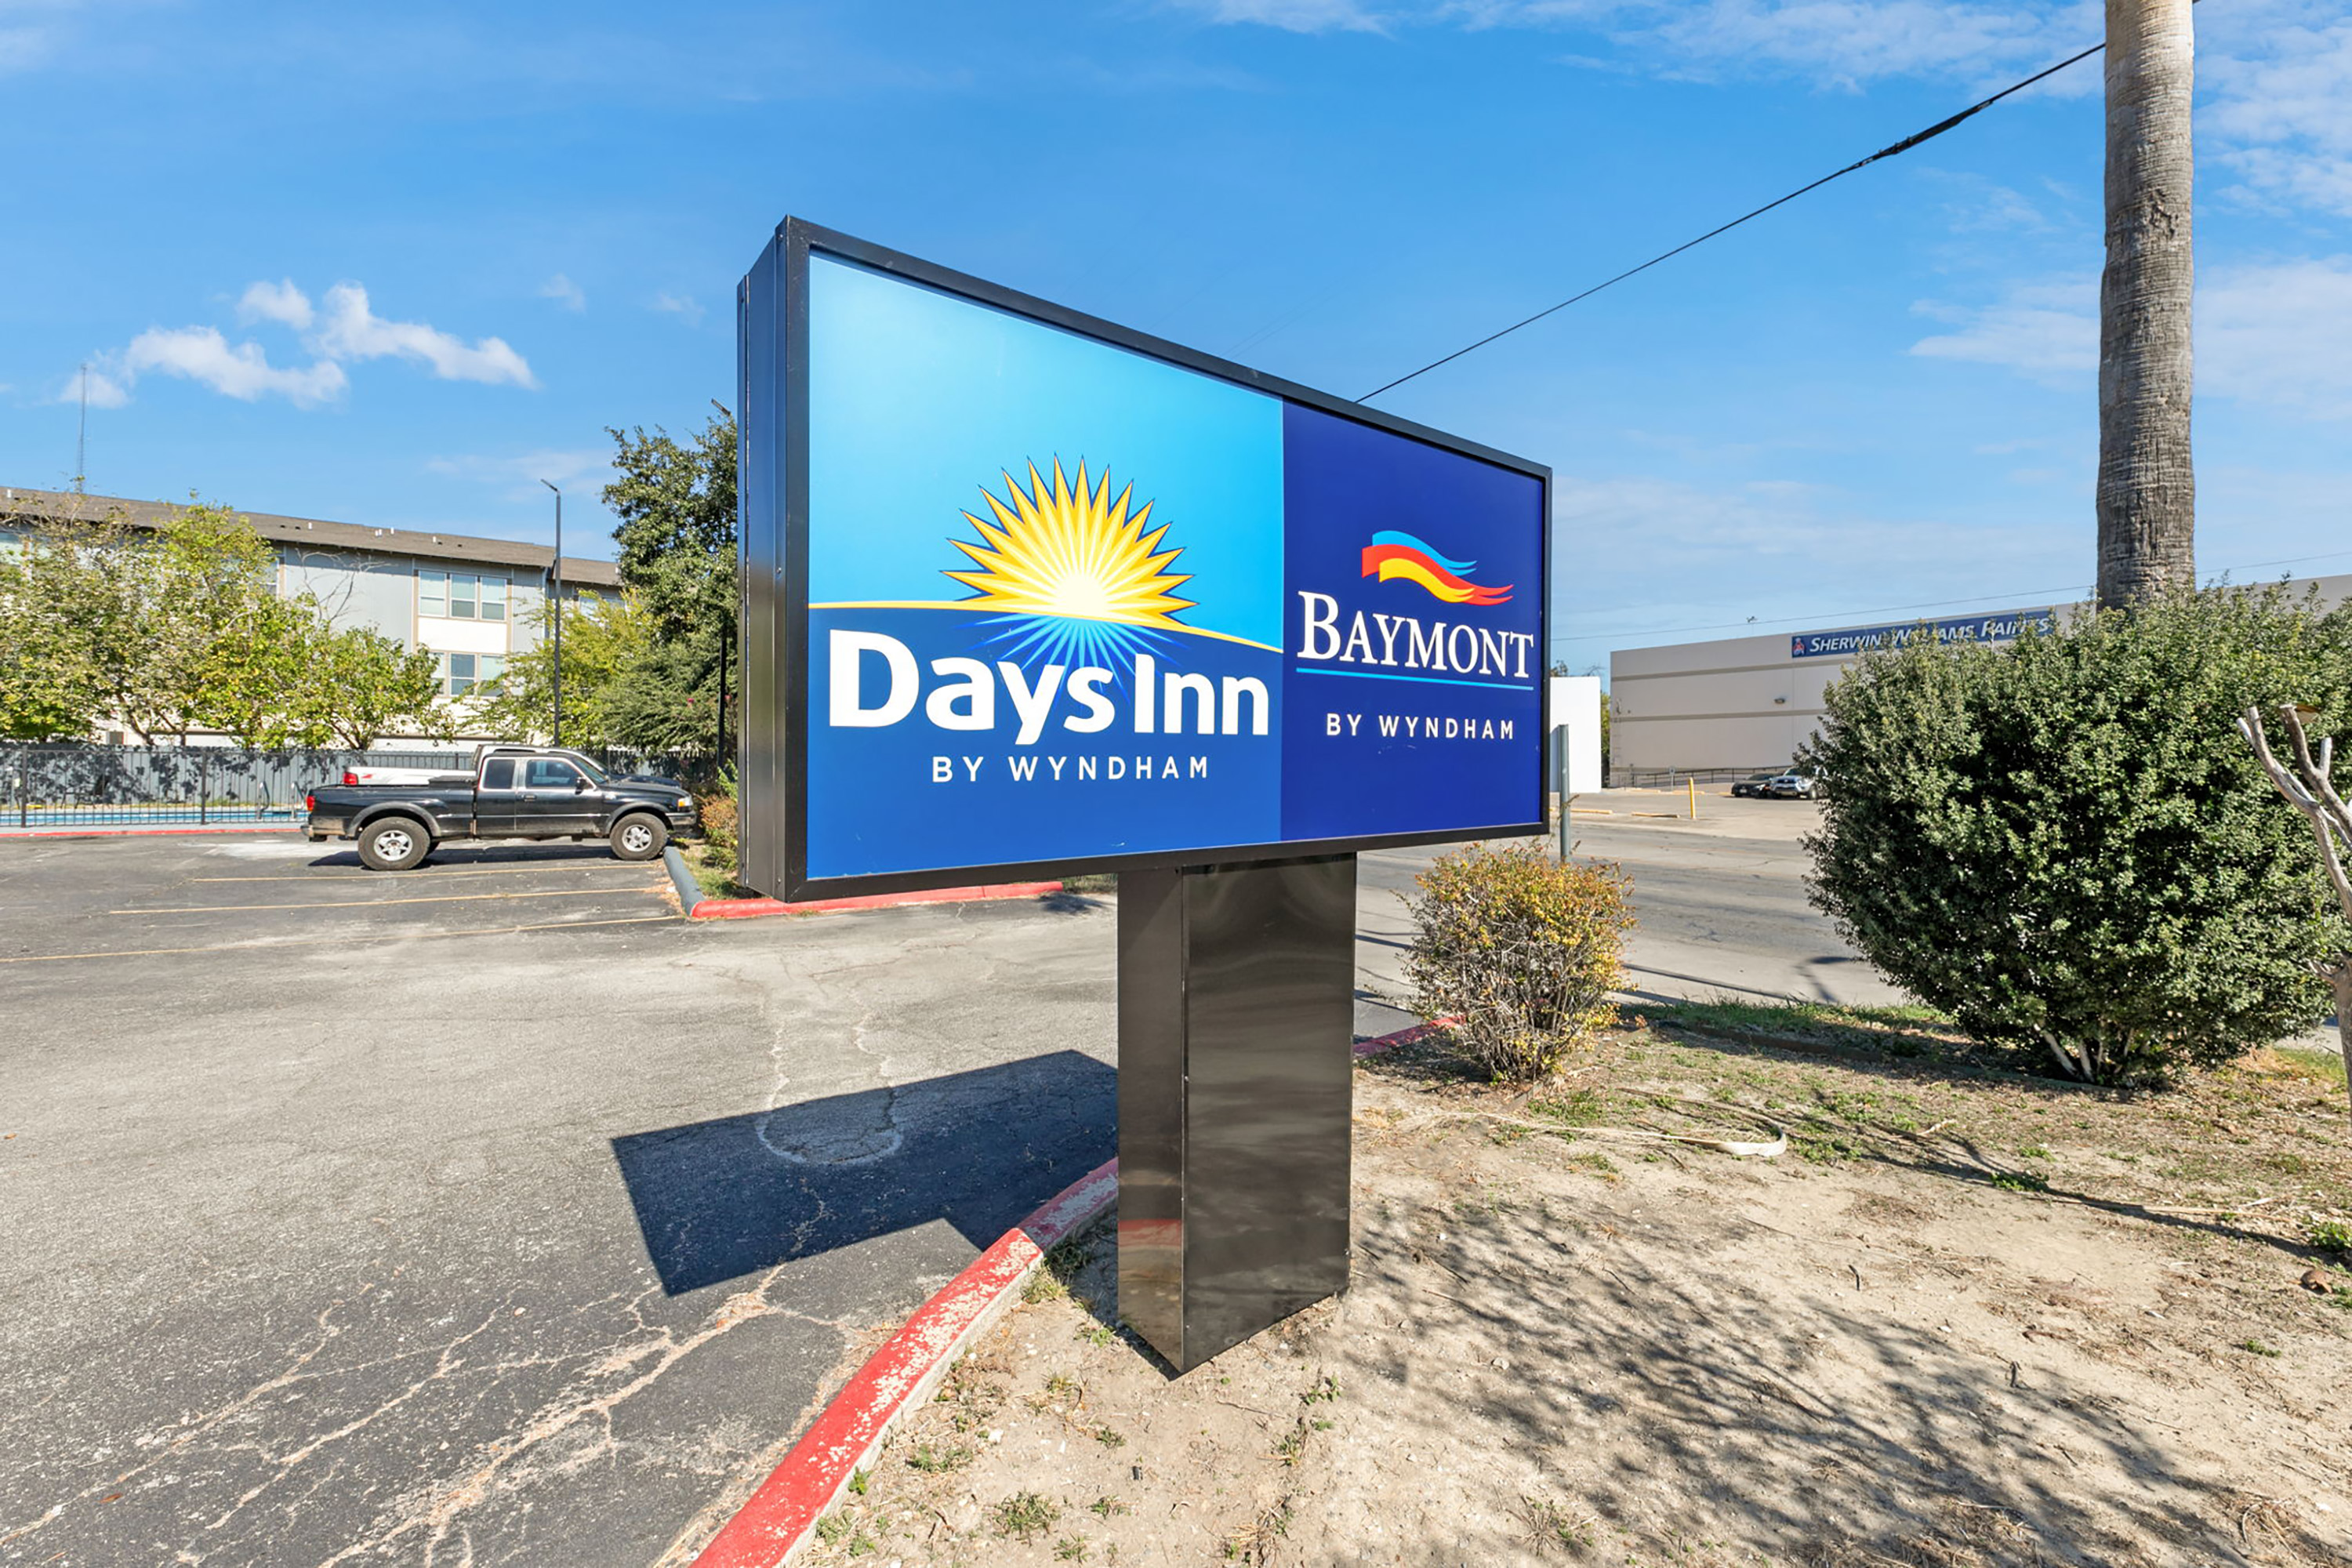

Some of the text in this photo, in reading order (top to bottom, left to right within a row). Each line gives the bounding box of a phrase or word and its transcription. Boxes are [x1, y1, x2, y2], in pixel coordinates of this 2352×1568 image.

[1298, 590, 1534, 678] BAYMONT
[1809, 634, 1882, 652] SHERWIN
[829, 629, 1269, 746] Days Inn
[1327, 713, 1513, 739] BY WYNDHAM
[932, 756, 1208, 782] BY WYNDHAM
